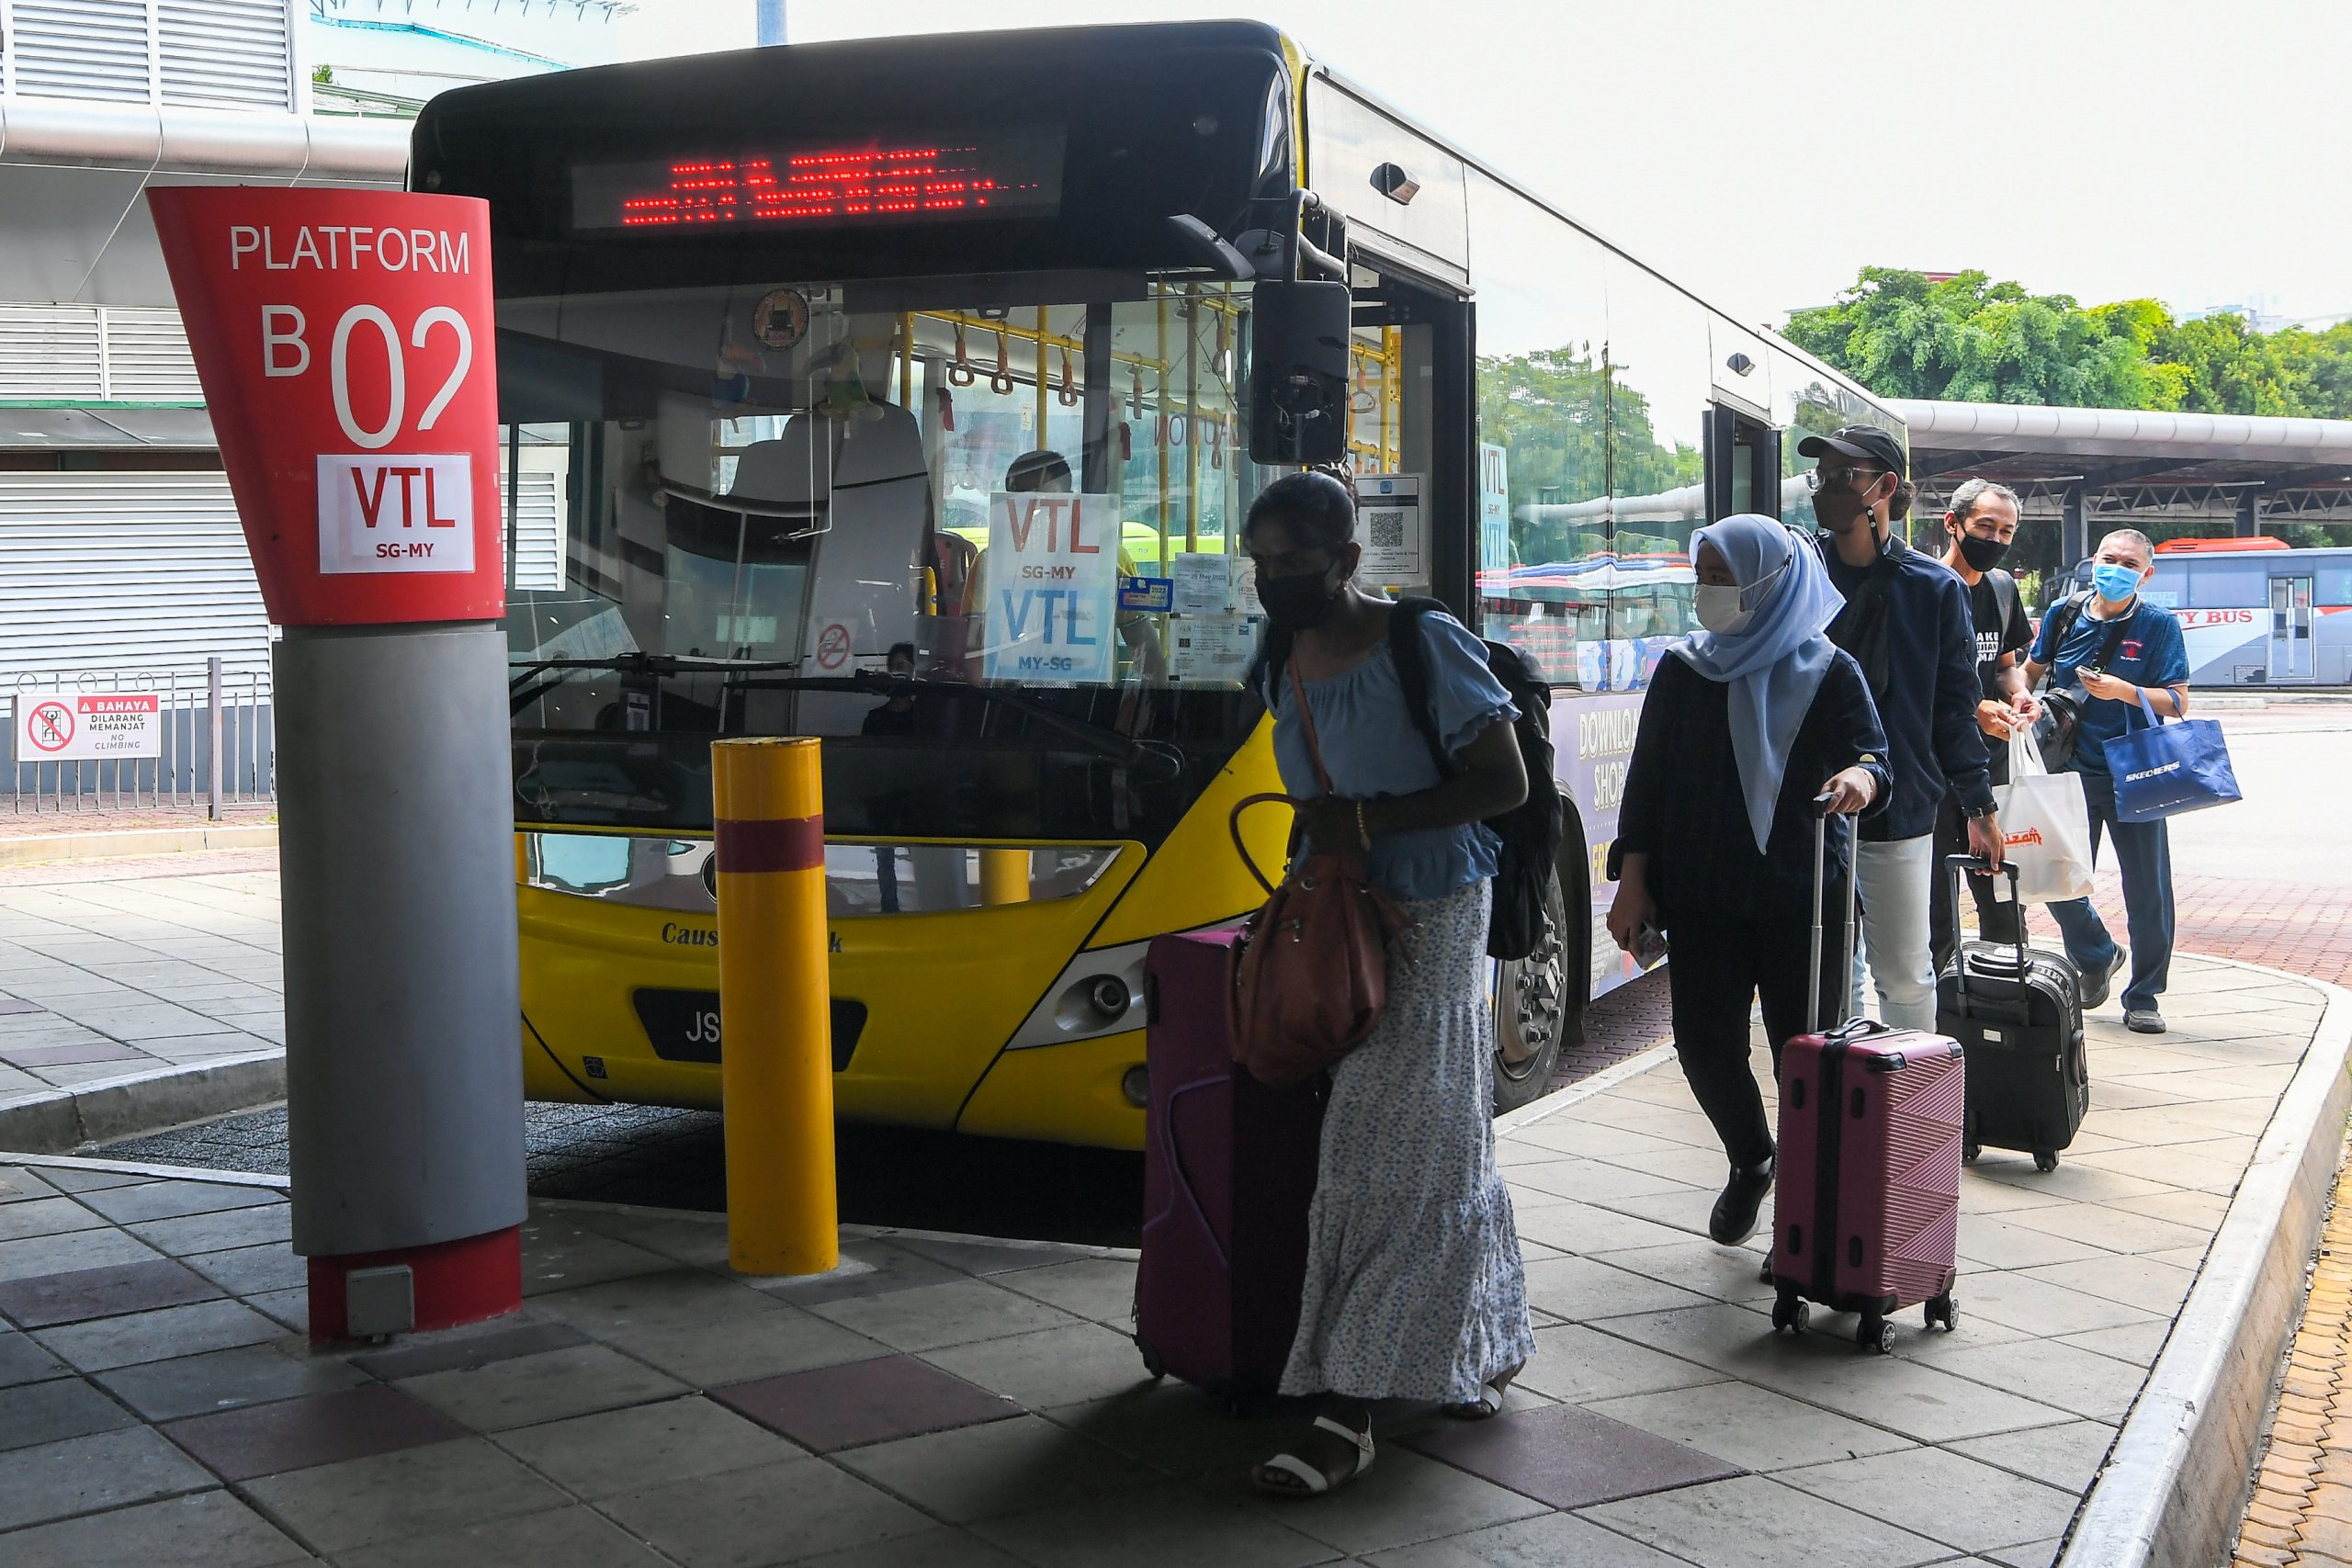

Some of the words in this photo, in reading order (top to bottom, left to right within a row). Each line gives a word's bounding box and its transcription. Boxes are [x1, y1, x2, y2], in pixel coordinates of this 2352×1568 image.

[231, 225, 469, 275] PLATFORM
[262, 305, 311, 378] B
[331, 303, 473, 449] 02
[1483, 448, 1505, 495] VTL
[351, 467, 456, 528] VTL
[1006, 499, 1101, 554] VTL
[376, 543, 435, 558] SG-MY
[1484, 523, 1505, 568] VTL
[1022, 565, 1077, 579] SG-MY
[1001, 589, 1097, 646] VTL
[2206, 610, 2253, 624] BUS
[1018, 656, 1073, 671] MY-SG
[91, 715, 143, 723] DILARANG
[96, 701, 151, 712] BAHAYA
[89, 722, 145, 731] MEMANJAT
[1579, 707, 1640, 761] DOWNLOA
[95, 741, 141, 750] CLIMBING
[2125, 761, 2181, 783] SKECHERS
[686, 1011, 720, 1043] JS
